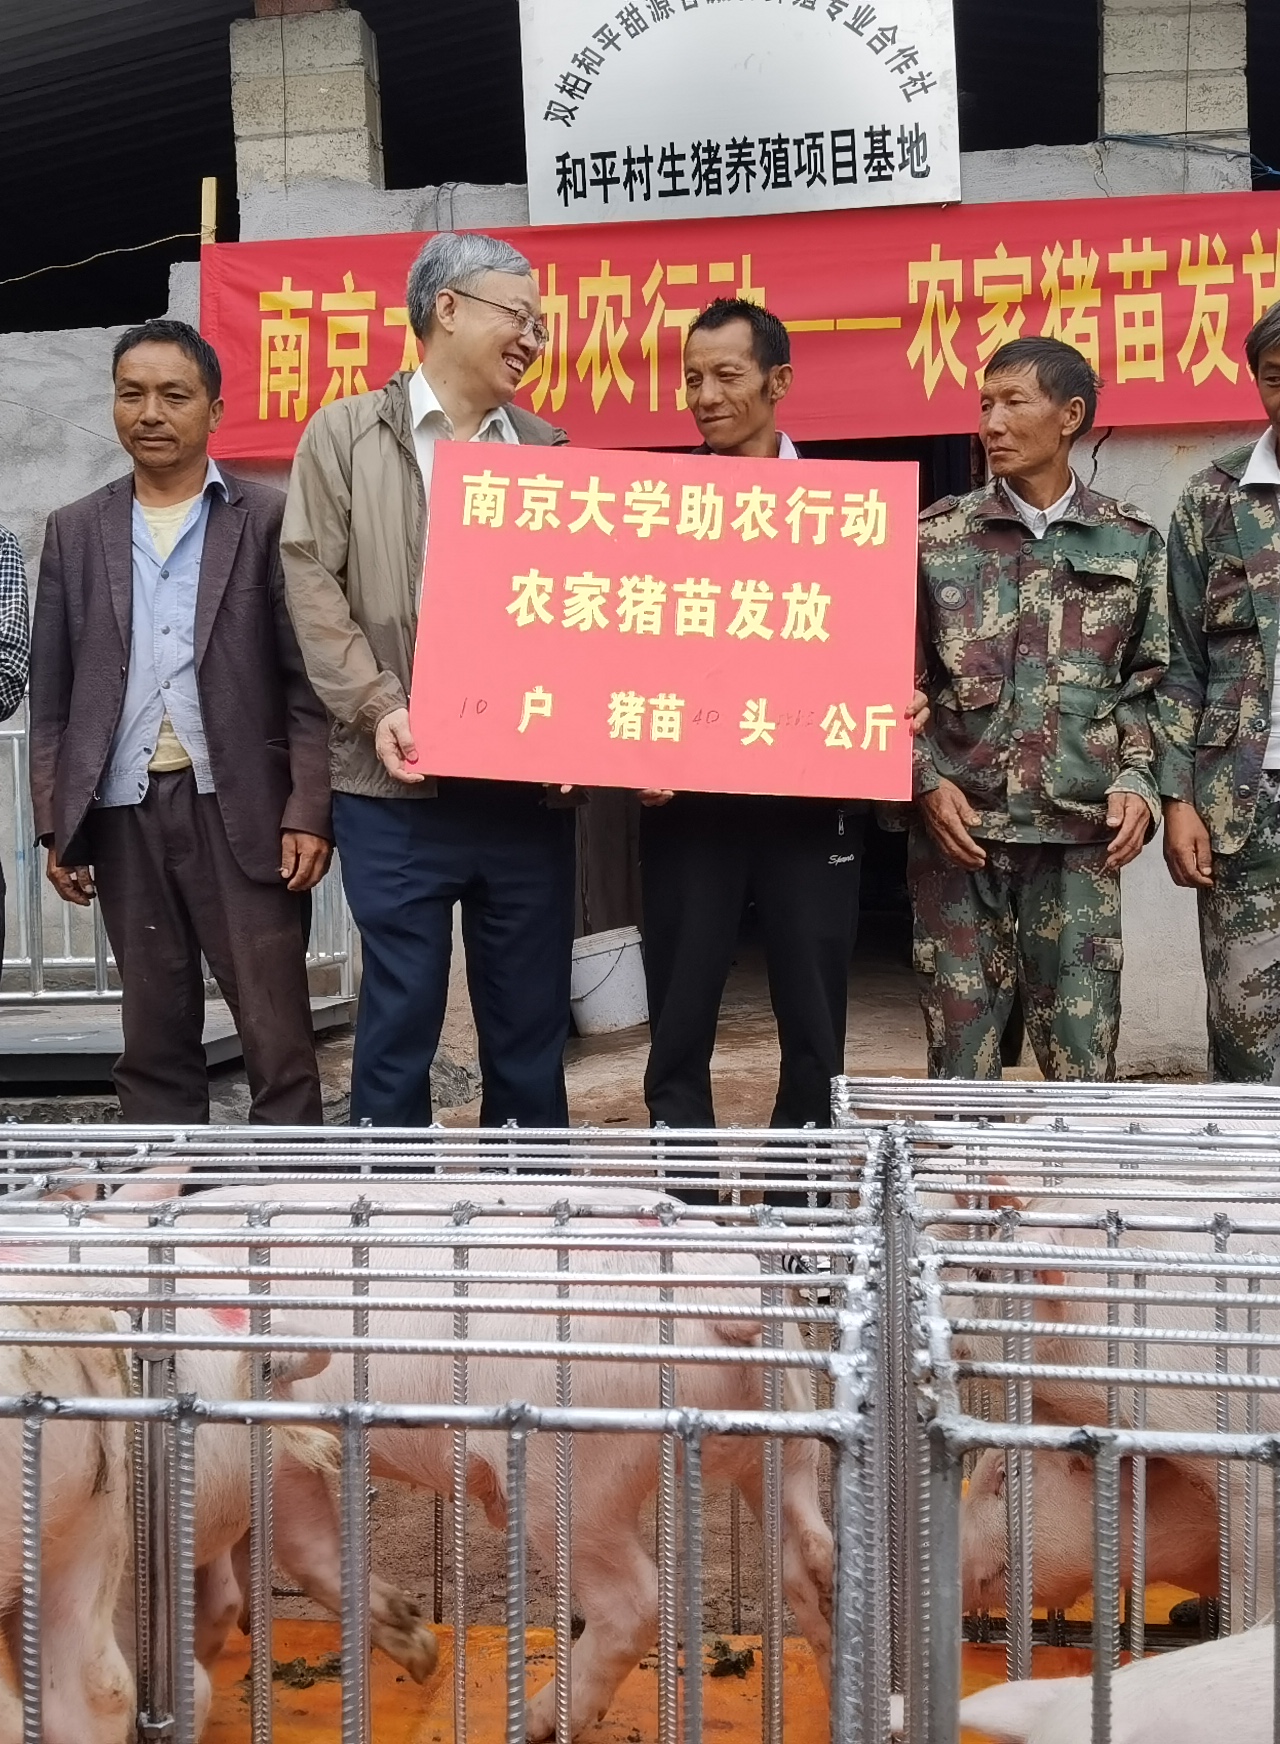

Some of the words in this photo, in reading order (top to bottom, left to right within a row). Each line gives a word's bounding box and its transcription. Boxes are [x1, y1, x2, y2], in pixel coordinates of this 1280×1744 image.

[543, 0, 939, 128] 双柏和平甜源专业合作社
[554, 122, 931, 208] 和平村生猪养殖项目基地
[461, 469, 888, 546] 南京大学助农行动
[505, 568, 832, 642] 农家猪苗发放
[459, 696, 488, 719] 10
[517, 685, 553, 734] 户
[607, 691, 686, 743] 猪苗
[739, 697, 776, 746] 头
[820, 702, 898, 752] 公斤
